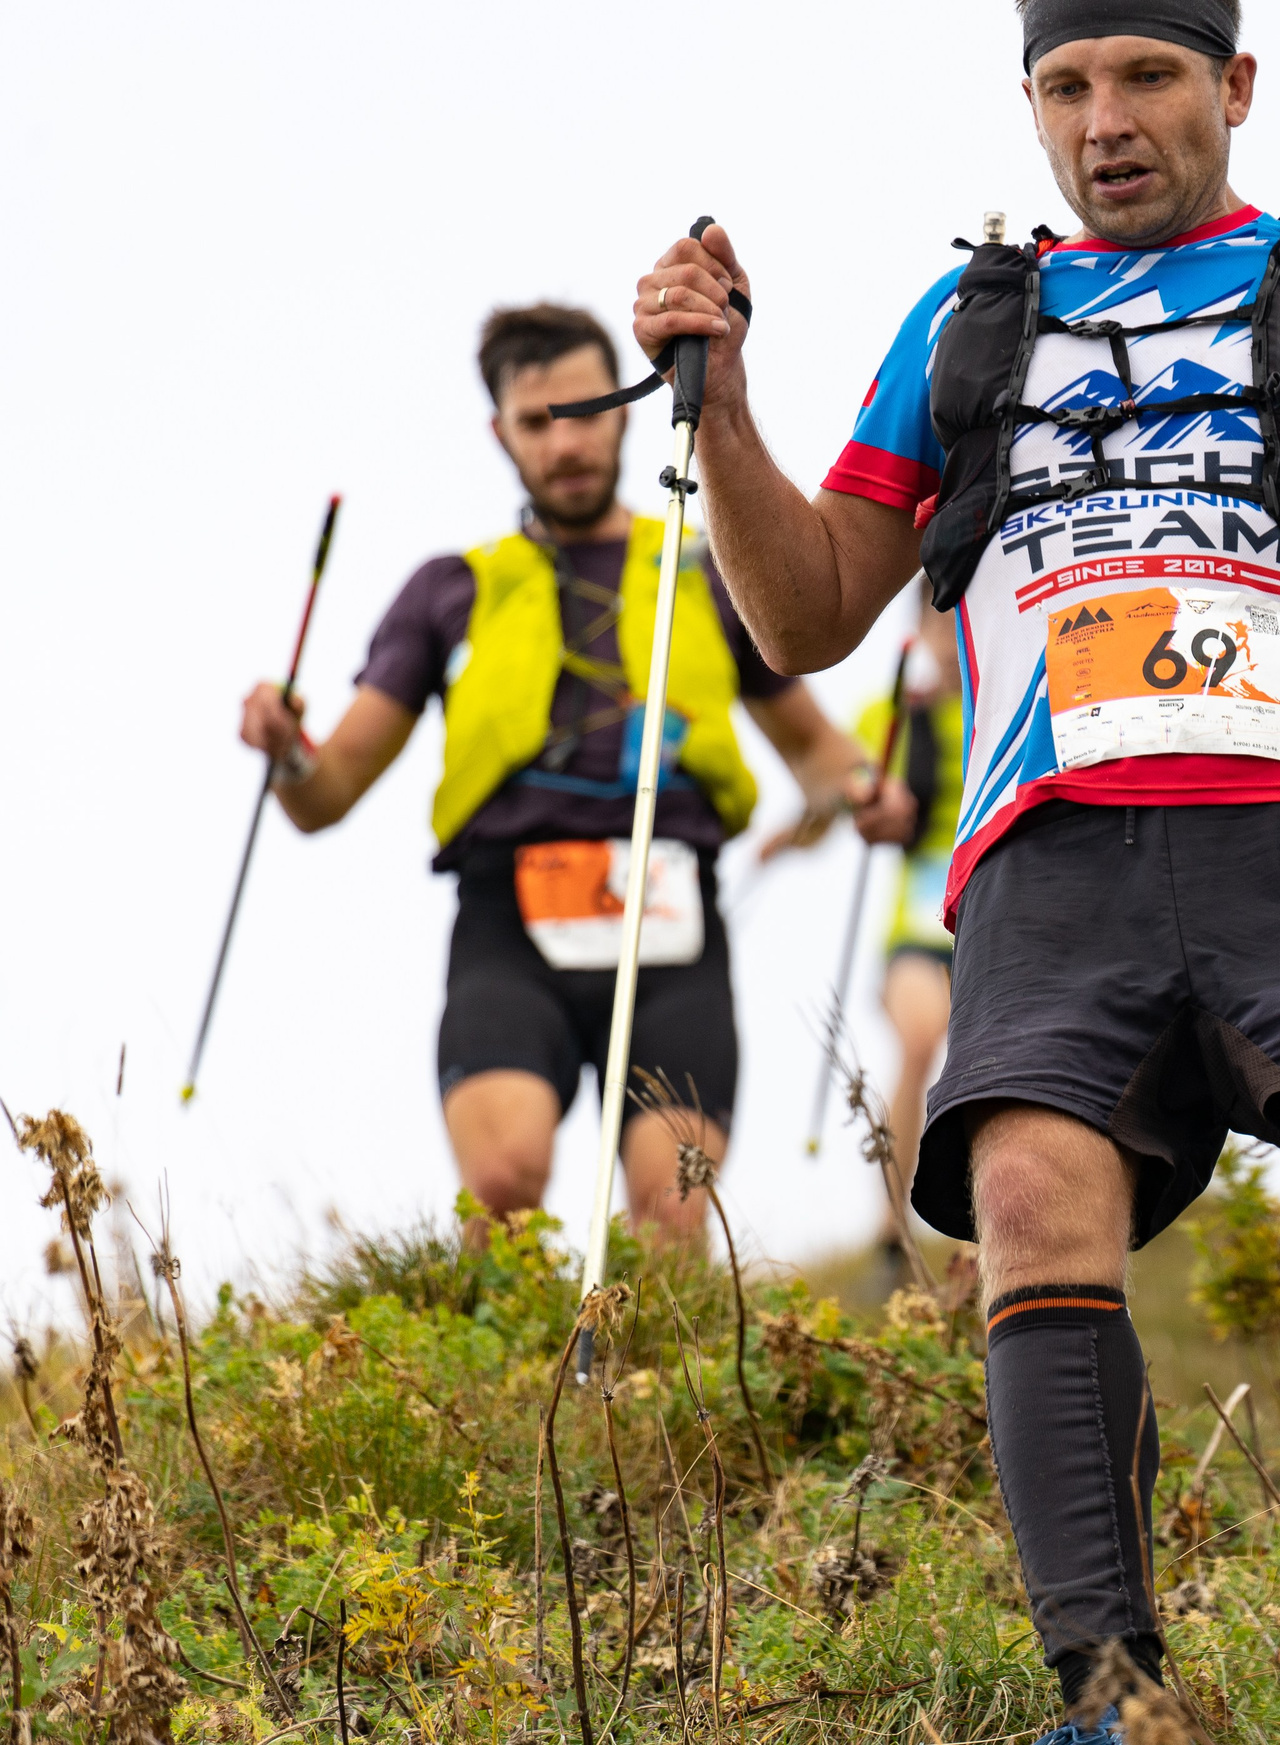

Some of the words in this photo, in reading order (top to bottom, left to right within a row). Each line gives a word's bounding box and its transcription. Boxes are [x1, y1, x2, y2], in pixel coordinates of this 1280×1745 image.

[1056, 559, 1145, 588] SINCE
[1163, 558, 1235, 578] 2014
[1080, 622, 1114, 633] RESORTS
[1142, 628, 1237, 690] 69
